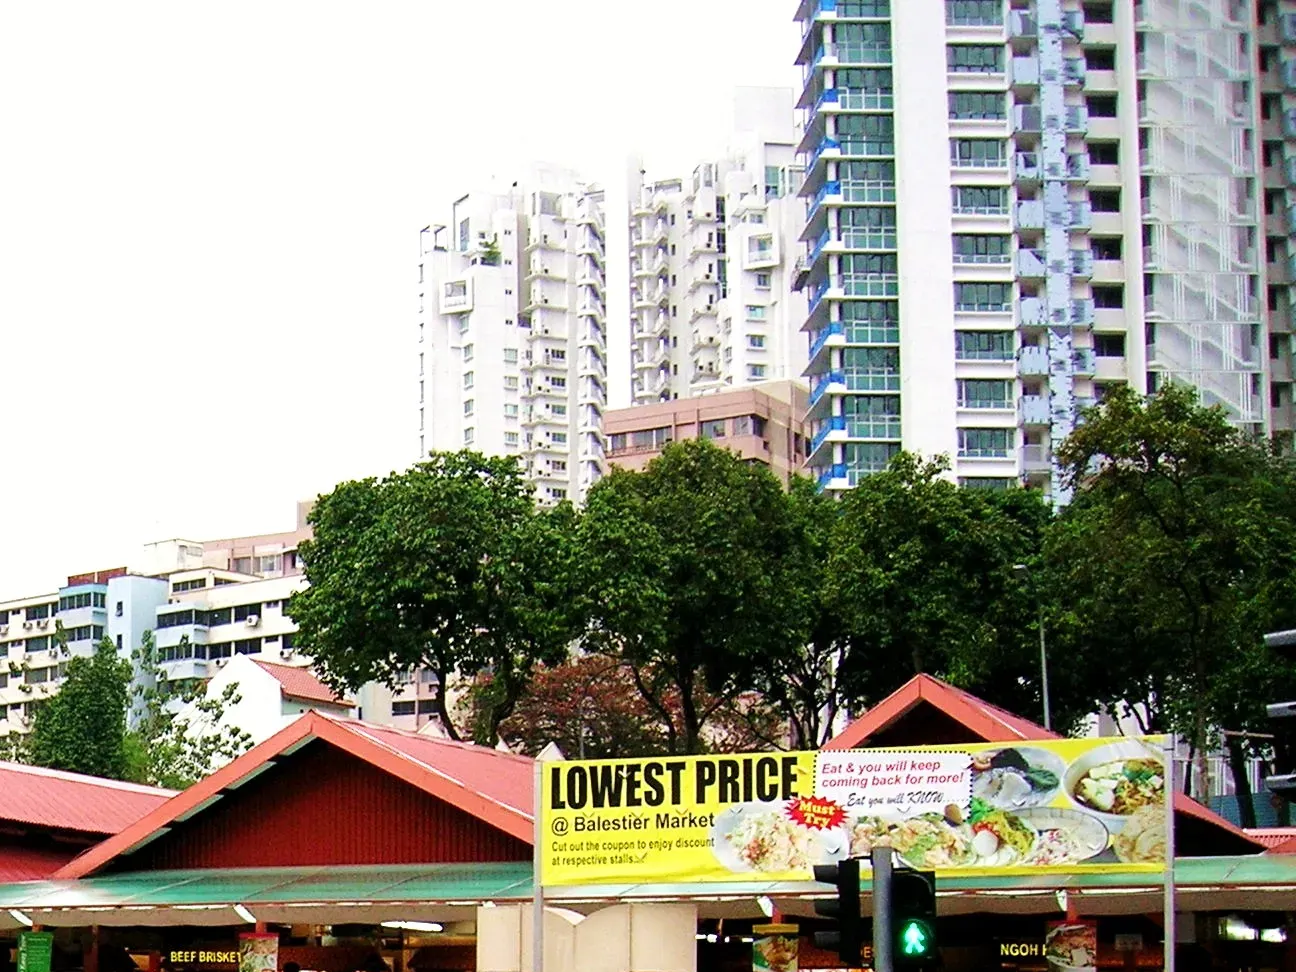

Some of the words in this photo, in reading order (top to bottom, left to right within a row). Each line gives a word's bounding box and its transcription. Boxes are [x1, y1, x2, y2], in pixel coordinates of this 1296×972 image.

[822, 763, 842, 774] Eat
[846, 763, 855, 773] &
[858, 764, 882, 776] you
[885, 761, 907, 772] will
[910, 760, 941, 773] keep
[551, 761, 686, 810] LOWEST
[696, 757, 799, 805] PRICE
[822, 776, 868, 788] coming
[872, 774, 902, 786] back
[906, 773, 924, 785] for
[926, 772, 964, 784] more!
[847, 792, 865, 807] Eat
[869, 796, 884, 808] you
[886, 791, 905, 804] will
[799, 800, 836, 816] Must
[551, 817, 569, 836] @
[575, 815, 650, 832] Balestier
[656, 812, 715, 829] Market
[804, 813, 831, 828] Try
[552, 840, 568, 852] Cut
[569, 841, 584, 852] out
[586, 840, 600, 851] the
[602, 841, 635, 854] coupon
[637, 839, 647, 850] to
[649, 838, 673, 851] enjoy
[675, 836, 715, 848] discount
[552, 857, 560, 866] at
[563, 856, 608, 868] respective
[170, 951, 196, 963] BEEF
[199, 951, 242, 963] BRISKET
[1000, 943, 1039, 956] NGOH
